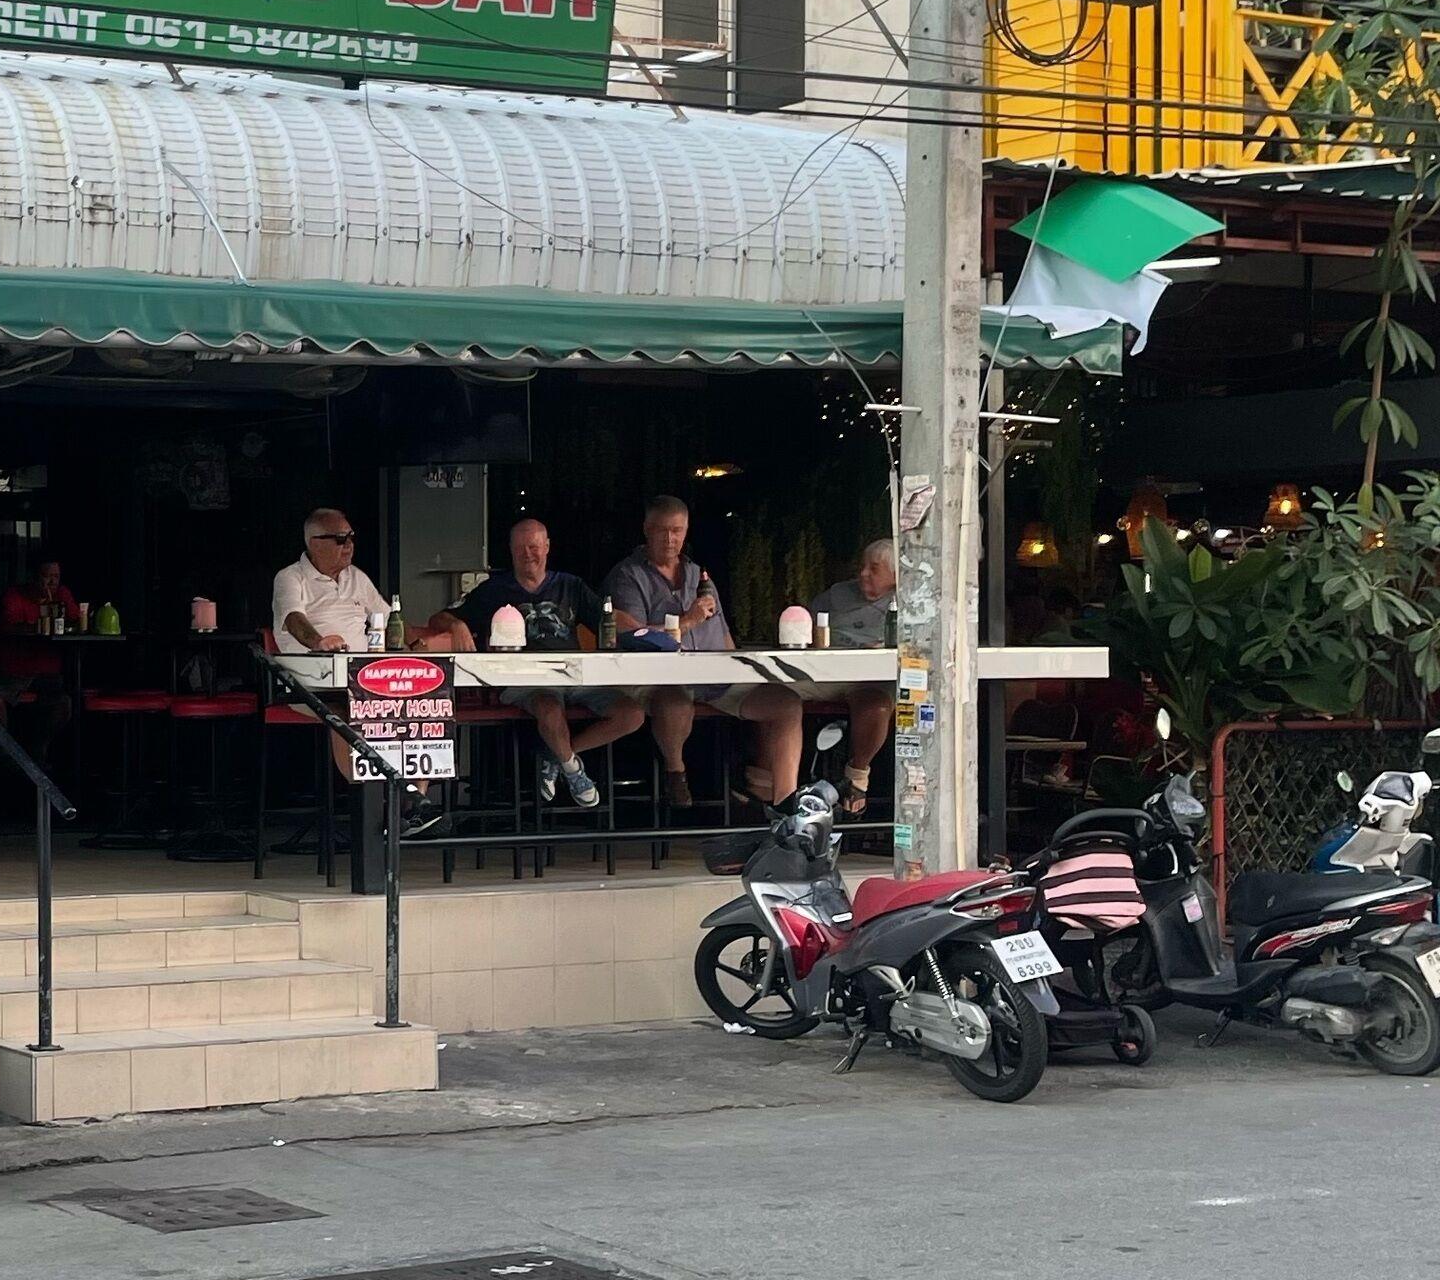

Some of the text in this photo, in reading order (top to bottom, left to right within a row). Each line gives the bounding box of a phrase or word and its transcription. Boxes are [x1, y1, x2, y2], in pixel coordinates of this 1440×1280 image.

[124, 13, 419, 66] 061-5842699
[364, 668, 438, 679] HAPPYAPPLE
[389, 681, 413, 691] BAR
[349, 699, 453, 719] HAPPY HOUR
[409, 723, 419, 738] 7
[421, 723, 445, 738] PM
[405, 753, 433, 776] 50
